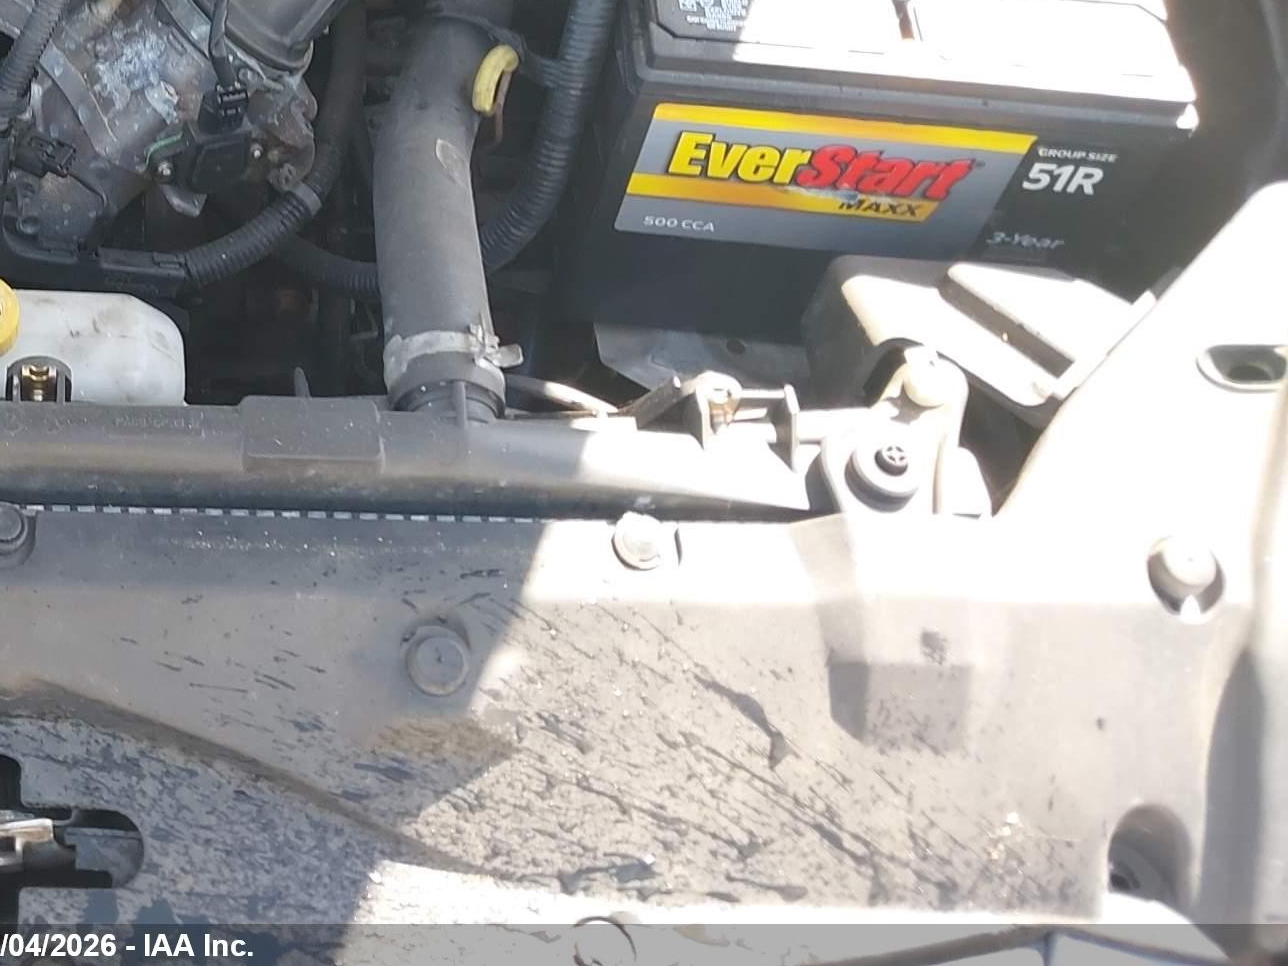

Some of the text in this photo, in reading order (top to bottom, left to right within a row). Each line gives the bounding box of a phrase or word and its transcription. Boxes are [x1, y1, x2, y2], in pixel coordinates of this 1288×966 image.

[1038, 147, 1118, 163] GROUP SIZE
[667, 129, 977, 201] EverStart
[1022, 162, 1104, 195] 51R
[838, 199, 922, 217] MAXX
[643, 216, 714, 232] 500 CCA
